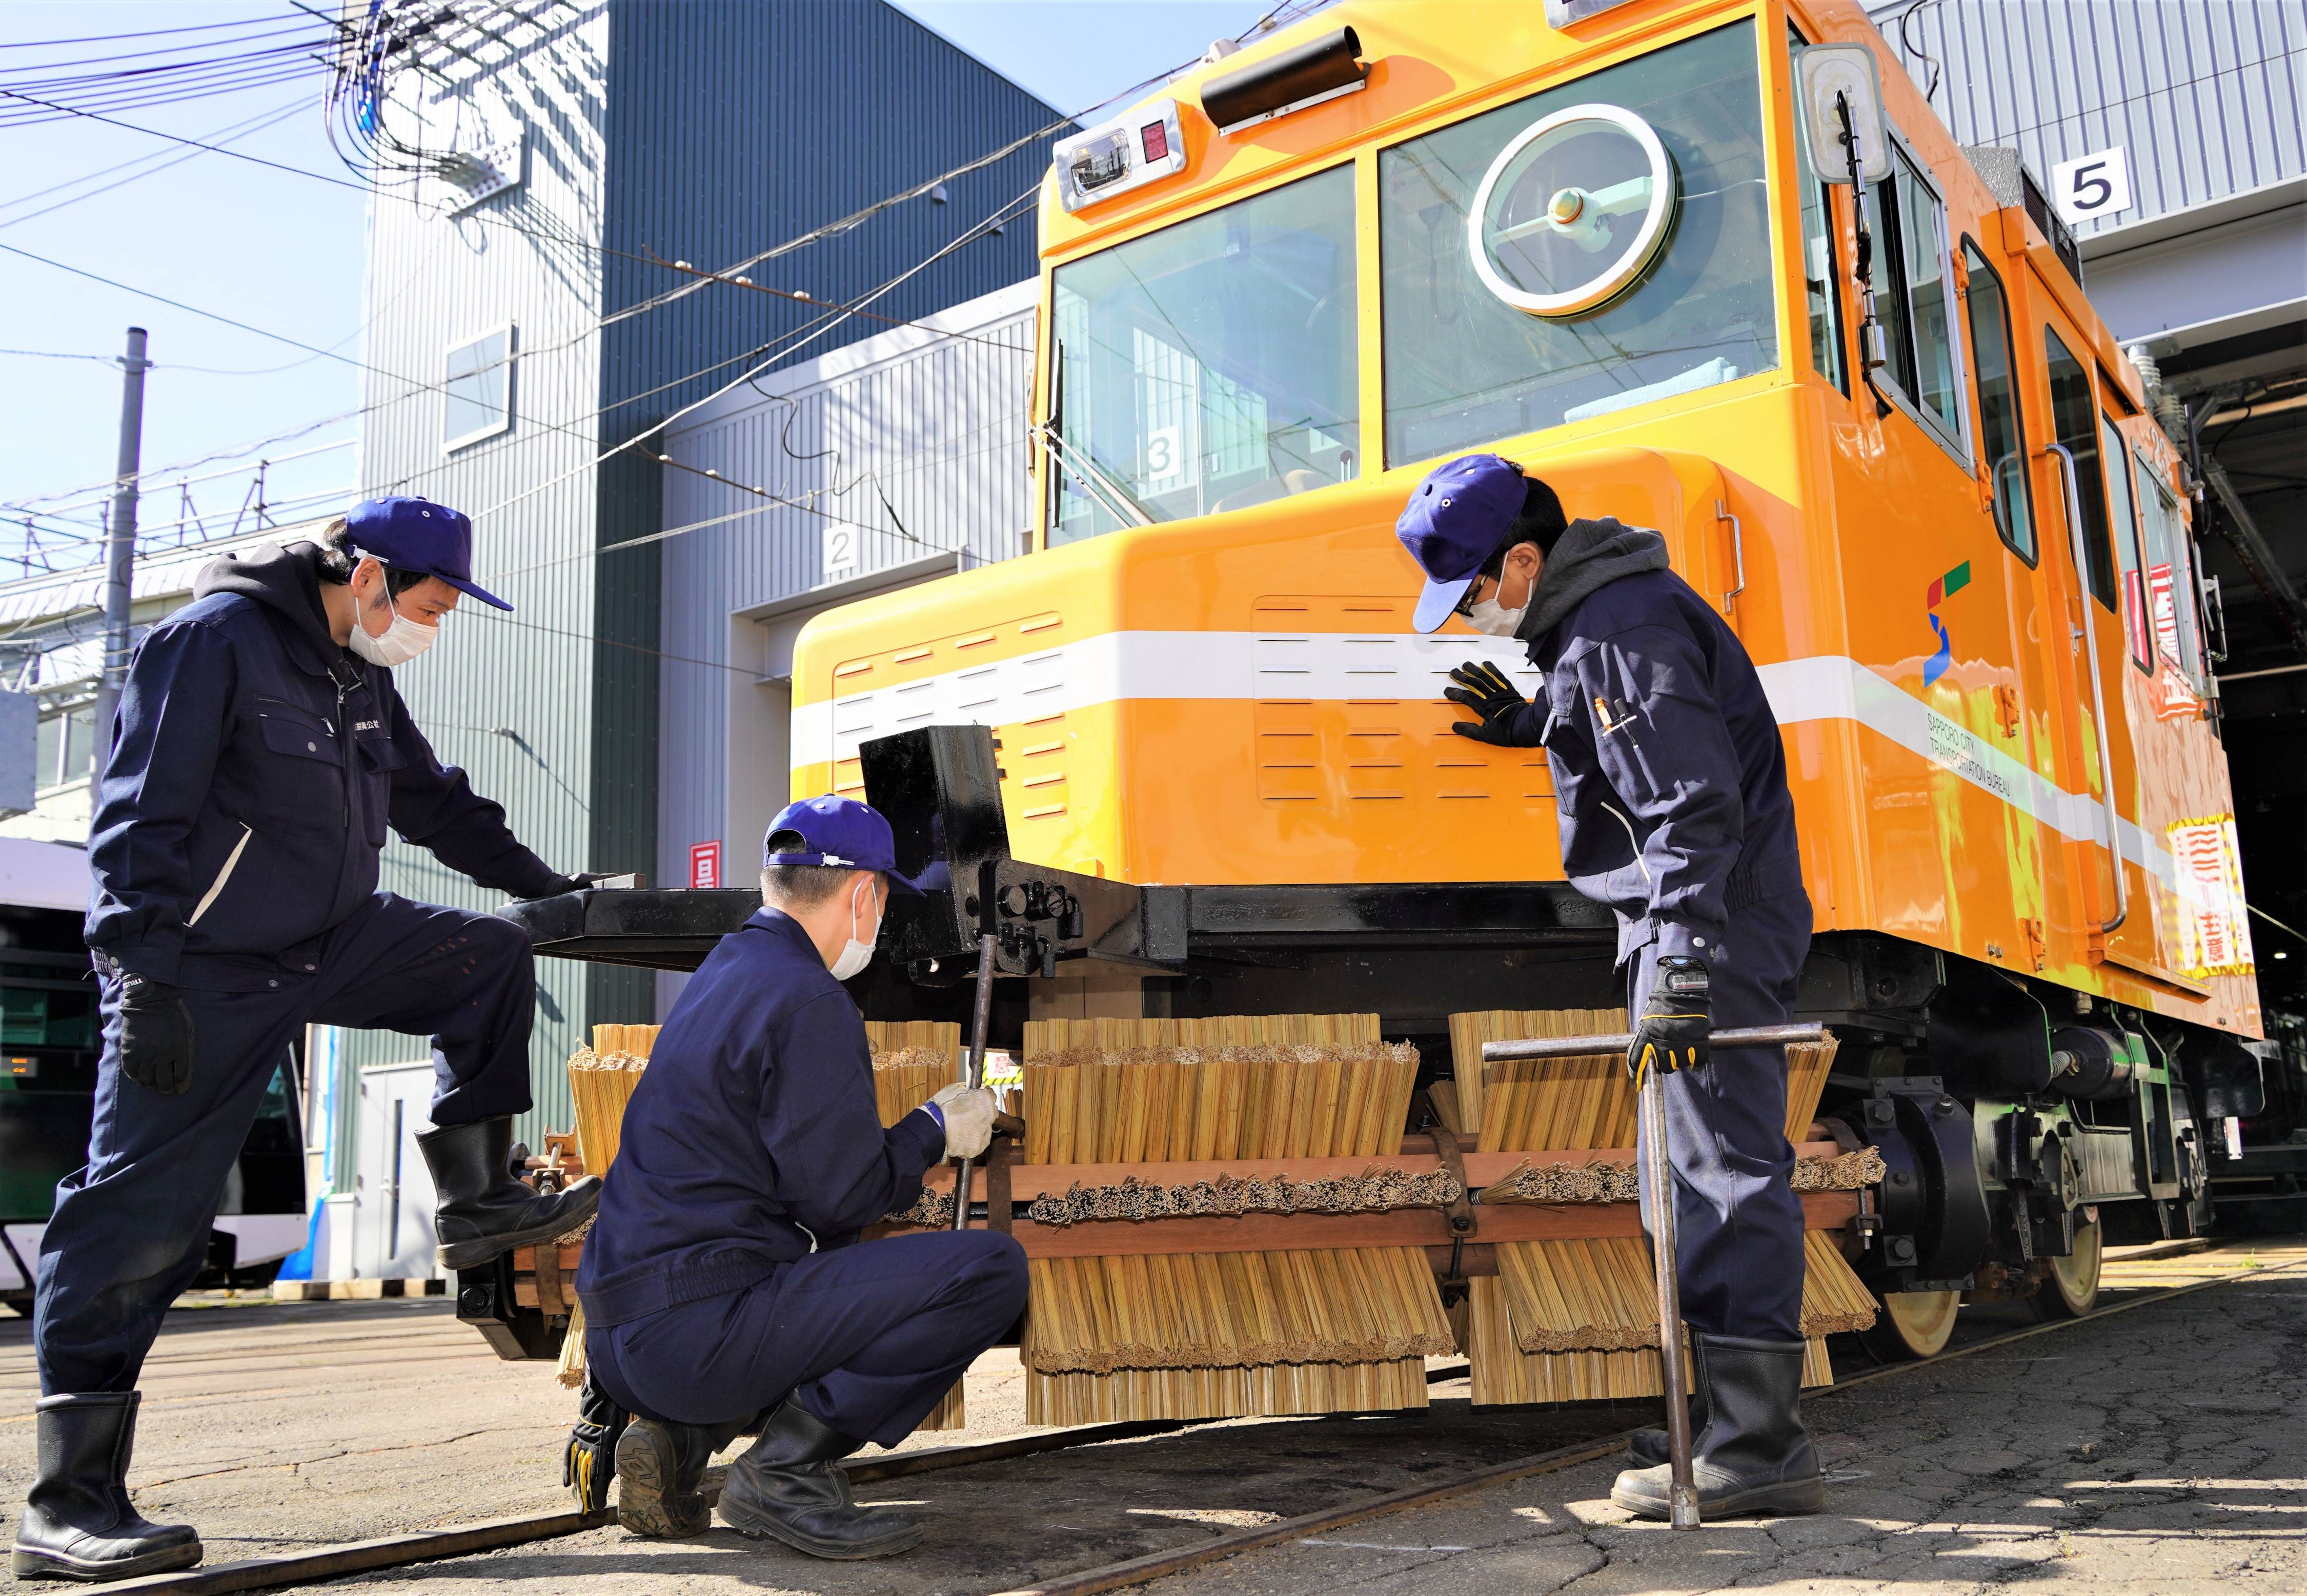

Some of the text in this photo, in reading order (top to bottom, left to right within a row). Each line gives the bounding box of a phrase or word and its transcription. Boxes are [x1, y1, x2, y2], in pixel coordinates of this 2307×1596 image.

[2073, 161, 2112, 210] 5
[1148, 437, 1170, 473] 3
[831, 532, 849, 564] 2
[1928, 713, 1974, 754] SAPPORO CITY
[1930, 737, 2010, 796] TRANSPORTATION BUREAU
